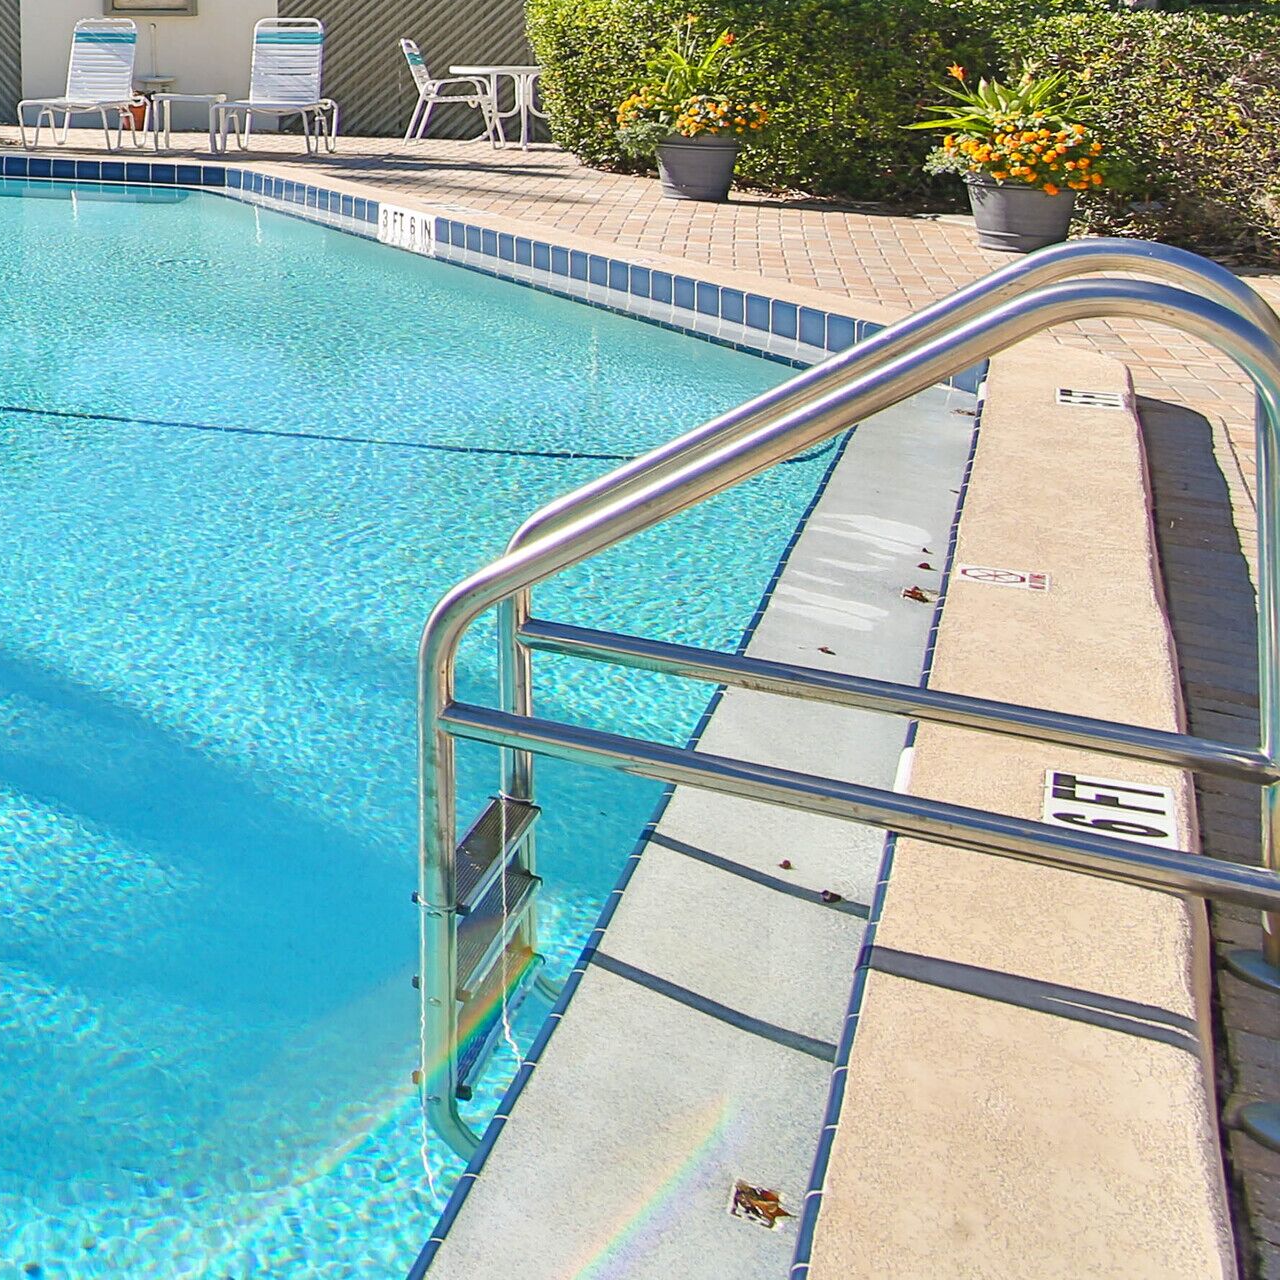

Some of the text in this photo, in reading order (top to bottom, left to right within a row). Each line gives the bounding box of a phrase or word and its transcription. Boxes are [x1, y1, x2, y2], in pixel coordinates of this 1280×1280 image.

[383, 209, 388, 227] 3
[410, 216, 416, 234] 6
[1052, 772, 1169, 837] 6 FT
